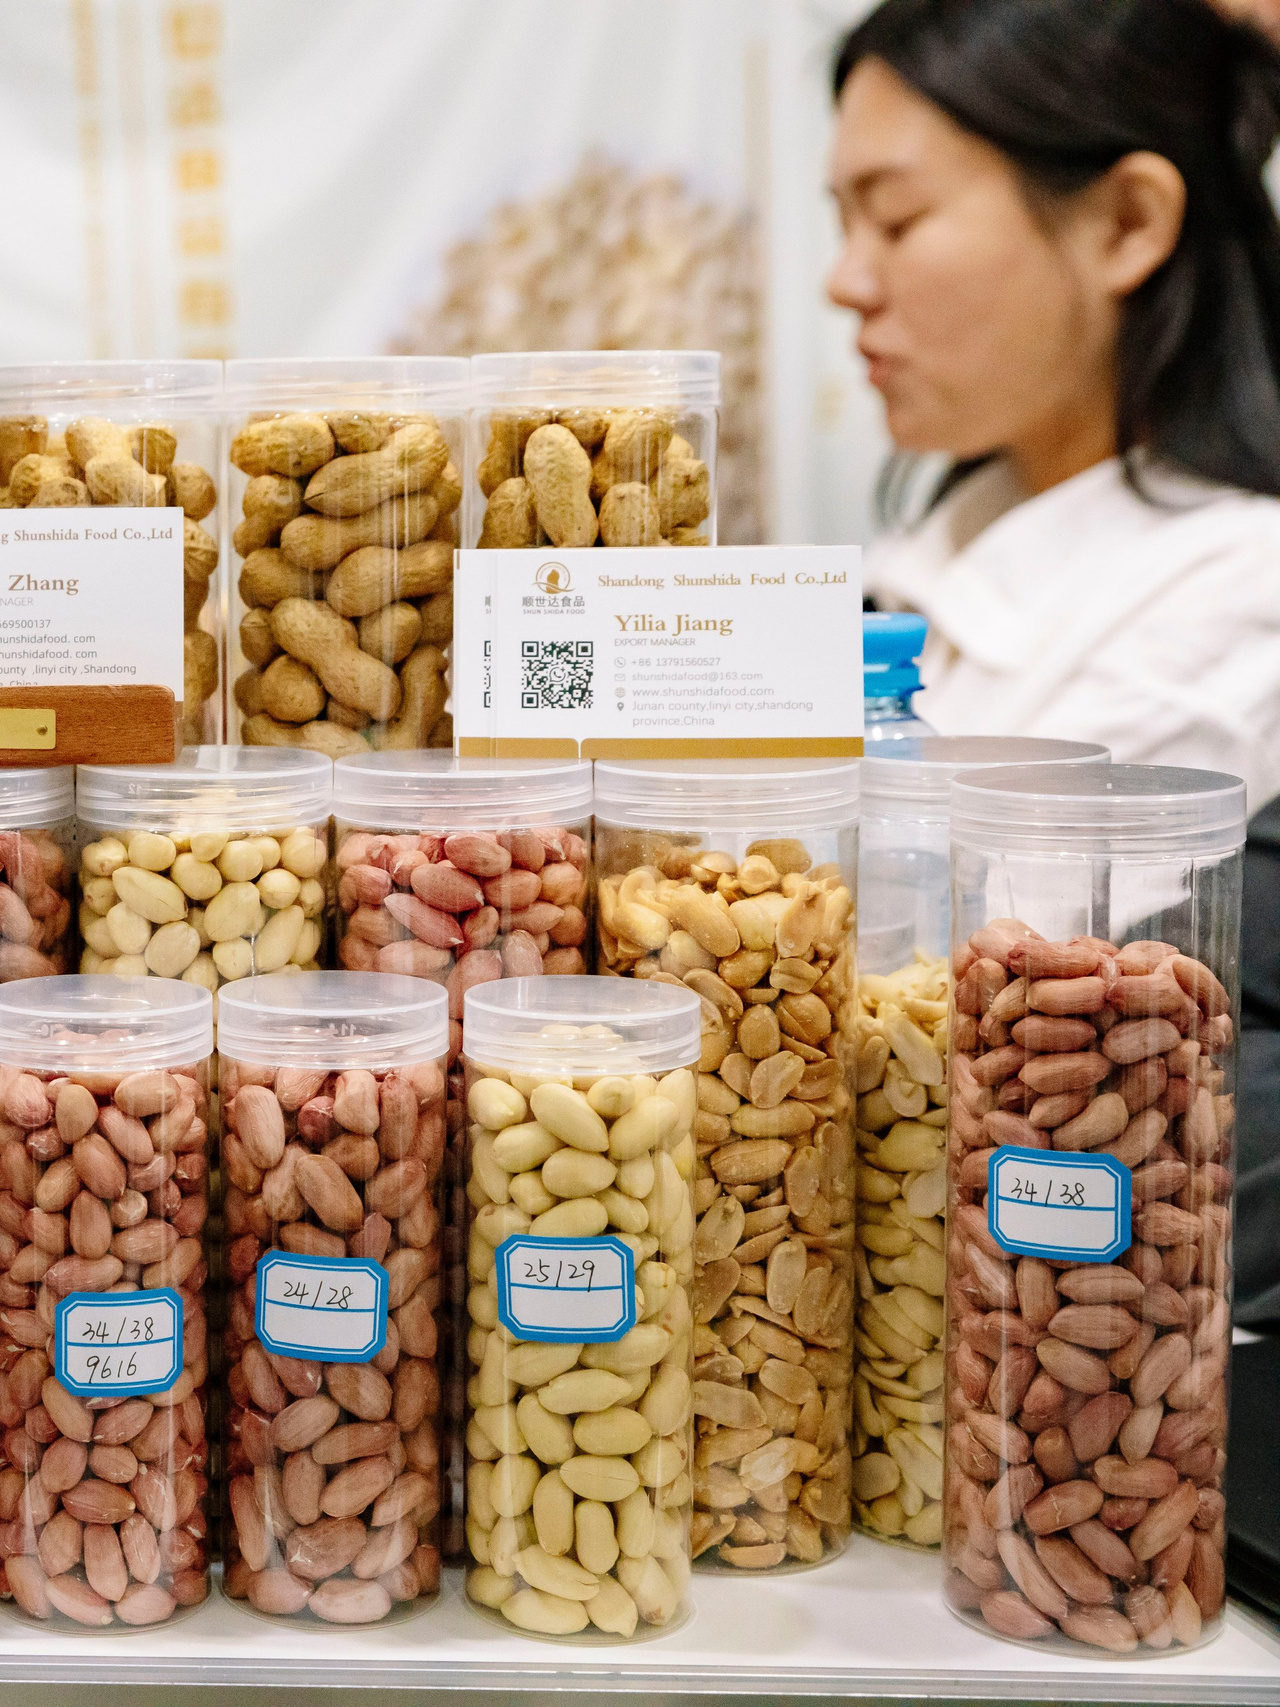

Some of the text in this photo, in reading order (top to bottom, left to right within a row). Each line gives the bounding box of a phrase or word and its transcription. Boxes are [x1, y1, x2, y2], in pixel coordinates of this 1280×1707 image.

[13, 528, 79, 542] Shunshida
[84, 528, 118, 540] Food
[122, 527, 174, 541] Co.,Ltd
[8, 574, 80, 596] Zhang
[598, 570, 848, 590] Shandong Shunshida Food Co.,Ltd
[522, 595, 586, 608] 顺世达食品
[614, 613, 734, 636] Yilia Jiang
[614, 638, 696, 647] EXPORT MANAGER
[75, 651, 98, 659] com
[59, 664, 78, 676] city
[631, 671, 763, 682] shunshidafood@163.com
[631, 687, 775, 697] www.shunshidafood.com
[631, 702, 665, 711] Junan
[1010, 1177, 1086, 1208] 34/38
[523, 1259, 596, 1293] 25/29
[282, 1280, 355, 1310] 24/28
[81, 1316, 156, 1345] 34/38
[85, 1351, 138, 1385] 9616
